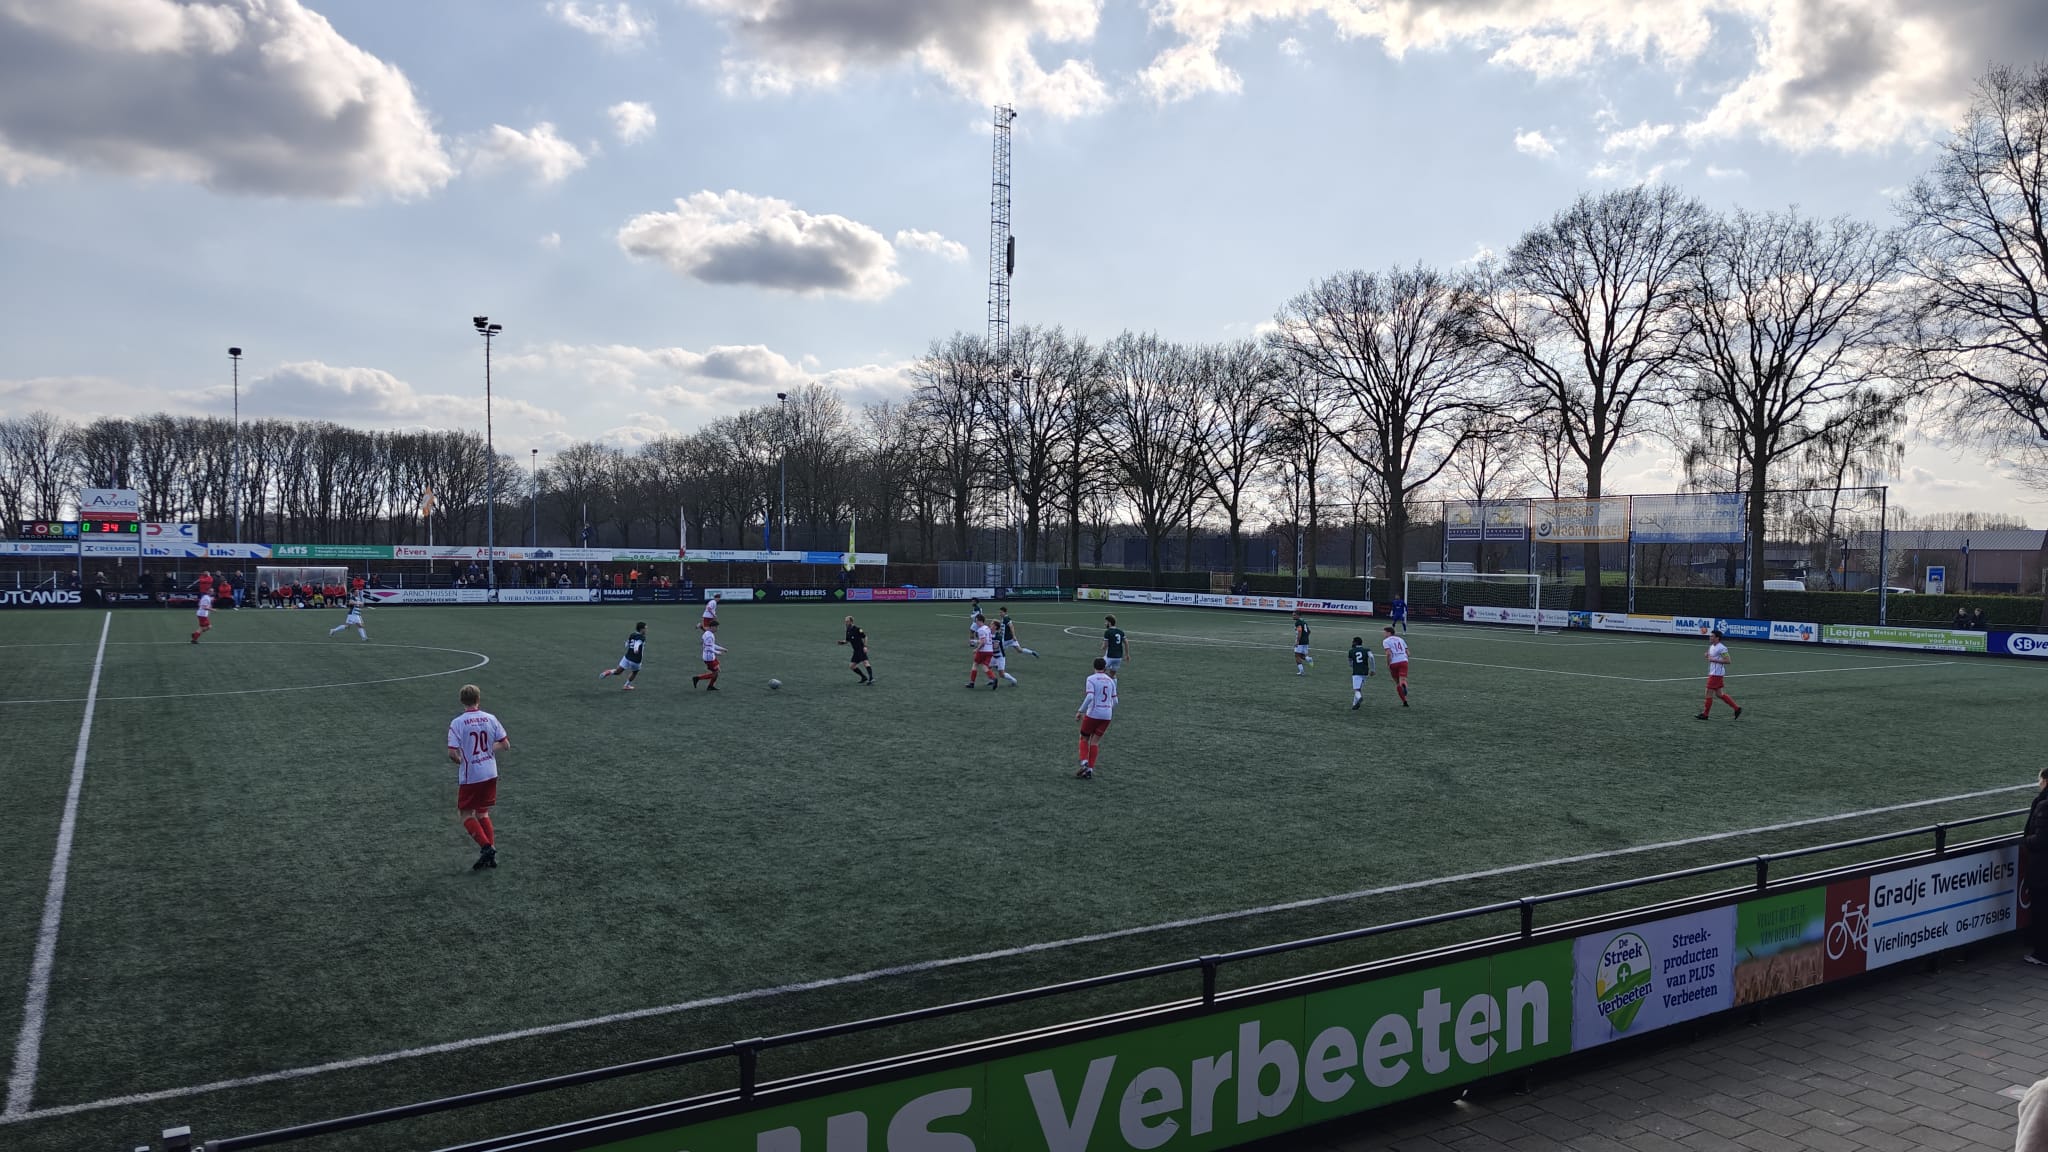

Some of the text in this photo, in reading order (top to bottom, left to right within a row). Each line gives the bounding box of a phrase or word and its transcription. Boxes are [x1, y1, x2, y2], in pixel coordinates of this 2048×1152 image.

[93, 496, 136, 508] Avydo
[22, 524, 78, 534] FOOX
[82, 523, 90, 533] 0
[101, 524, 119, 533] 34
[130, 524, 138, 533] 0
[403, 548, 427, 557] Evers
[483, 549, 506, 558] Eers
[780, 589, 828, 597] JOHN EBBERS
[1296, 600, 1321, 609] Harm
[1322, 601, 1358, 611] Martens
[1114, 633, 1122, 645] 3
[1355, 651, 1363, 663] 2
[1101, 686, 1108, 702] 5
[470, 730, 488, 755] 20
[1874, 861, 2015, 908] Gradje Tweewielers
[1672, 928, 1712, 950] Streek-
[1873, 921, 1949, 954] Vierlingsbeek
[1618, 938, 1628, 950] De
[1604, 943, 1643, 969] Streek
[1663, 946, 1719, 972] producten
[1666, 964, 1715, 990] van PLUS
[1597, 982, 1653, 1018] Verbeeten
[1664, 983, 1718, 1010] Verbeeten
[1023, 979, 1551, 1152] Verbeeten
